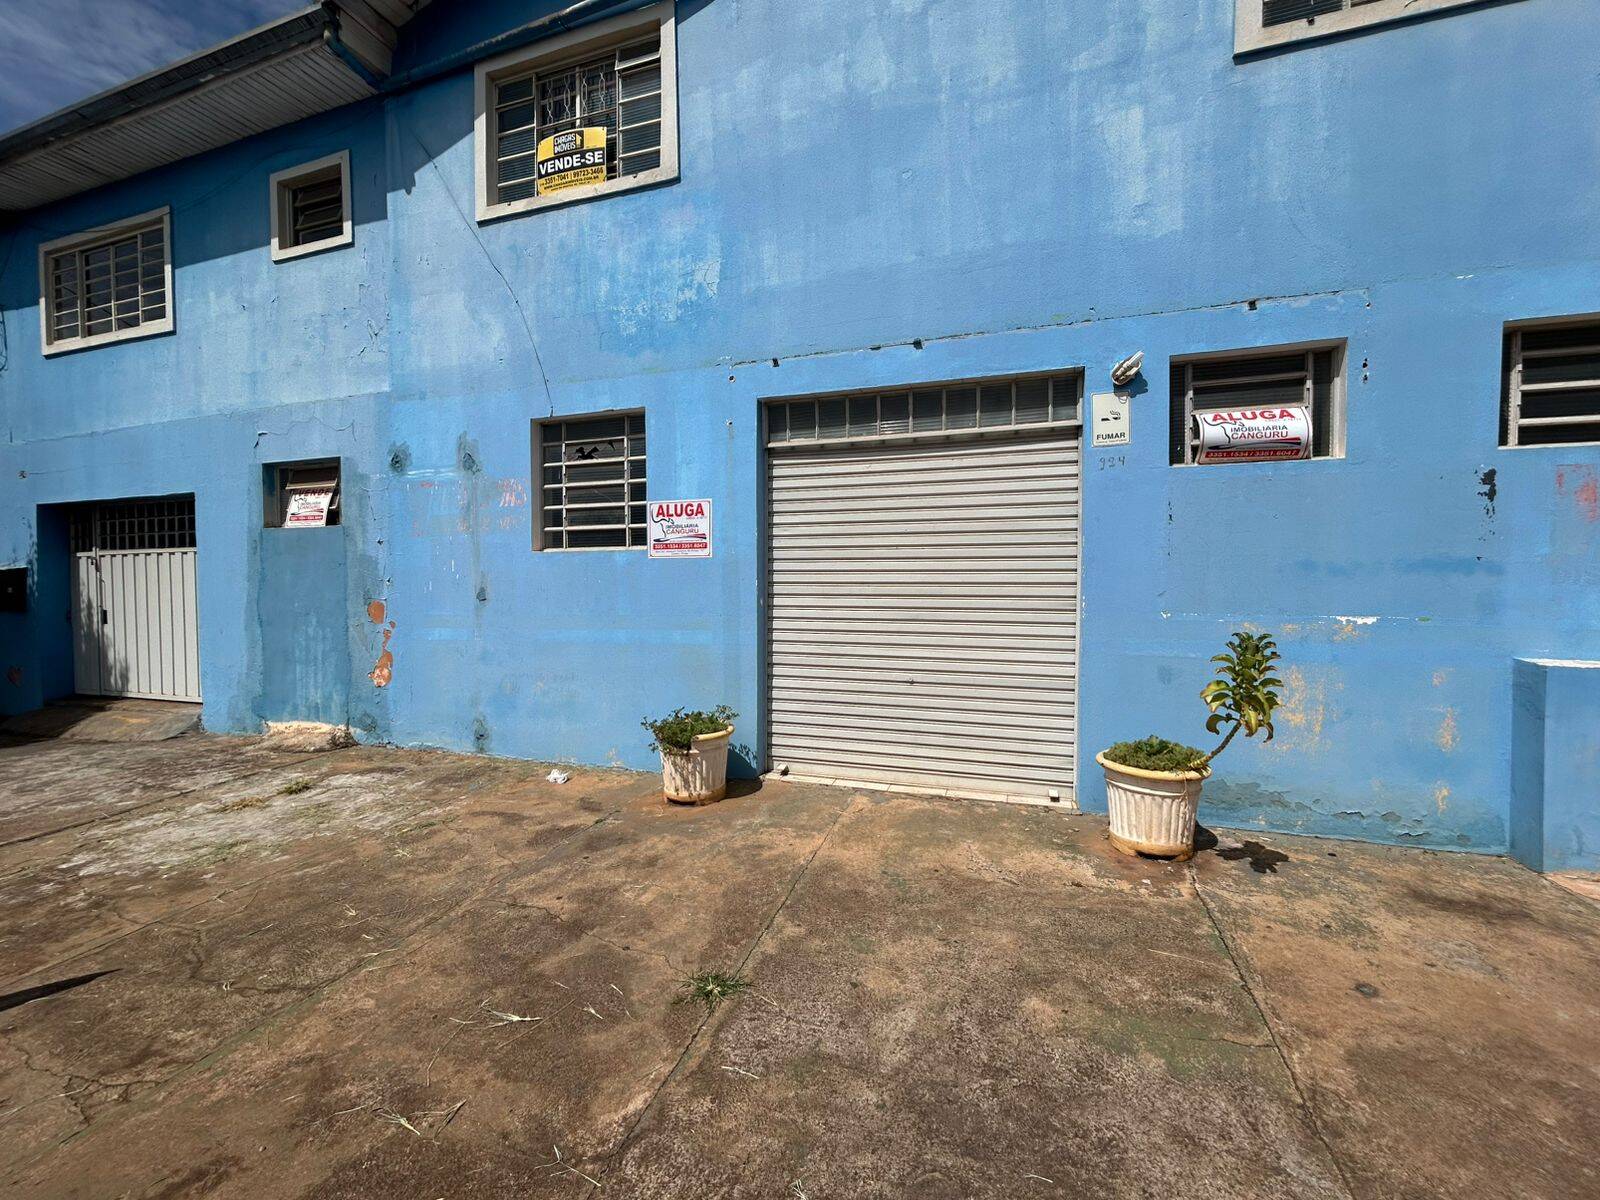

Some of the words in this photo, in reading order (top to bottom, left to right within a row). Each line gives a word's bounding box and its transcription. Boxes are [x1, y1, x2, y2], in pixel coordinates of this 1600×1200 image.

[554, 133, 576, 144] CHAGAS
[539, 151, 604, 175] VENDE-SE
[1212, 409, 1296, 422] ALUGA
[1096, 432, 1126, 440] FUMAR
[1231, 431, 1289, 440] CANGURU
[656, 502, 705, 518] ALUGA
